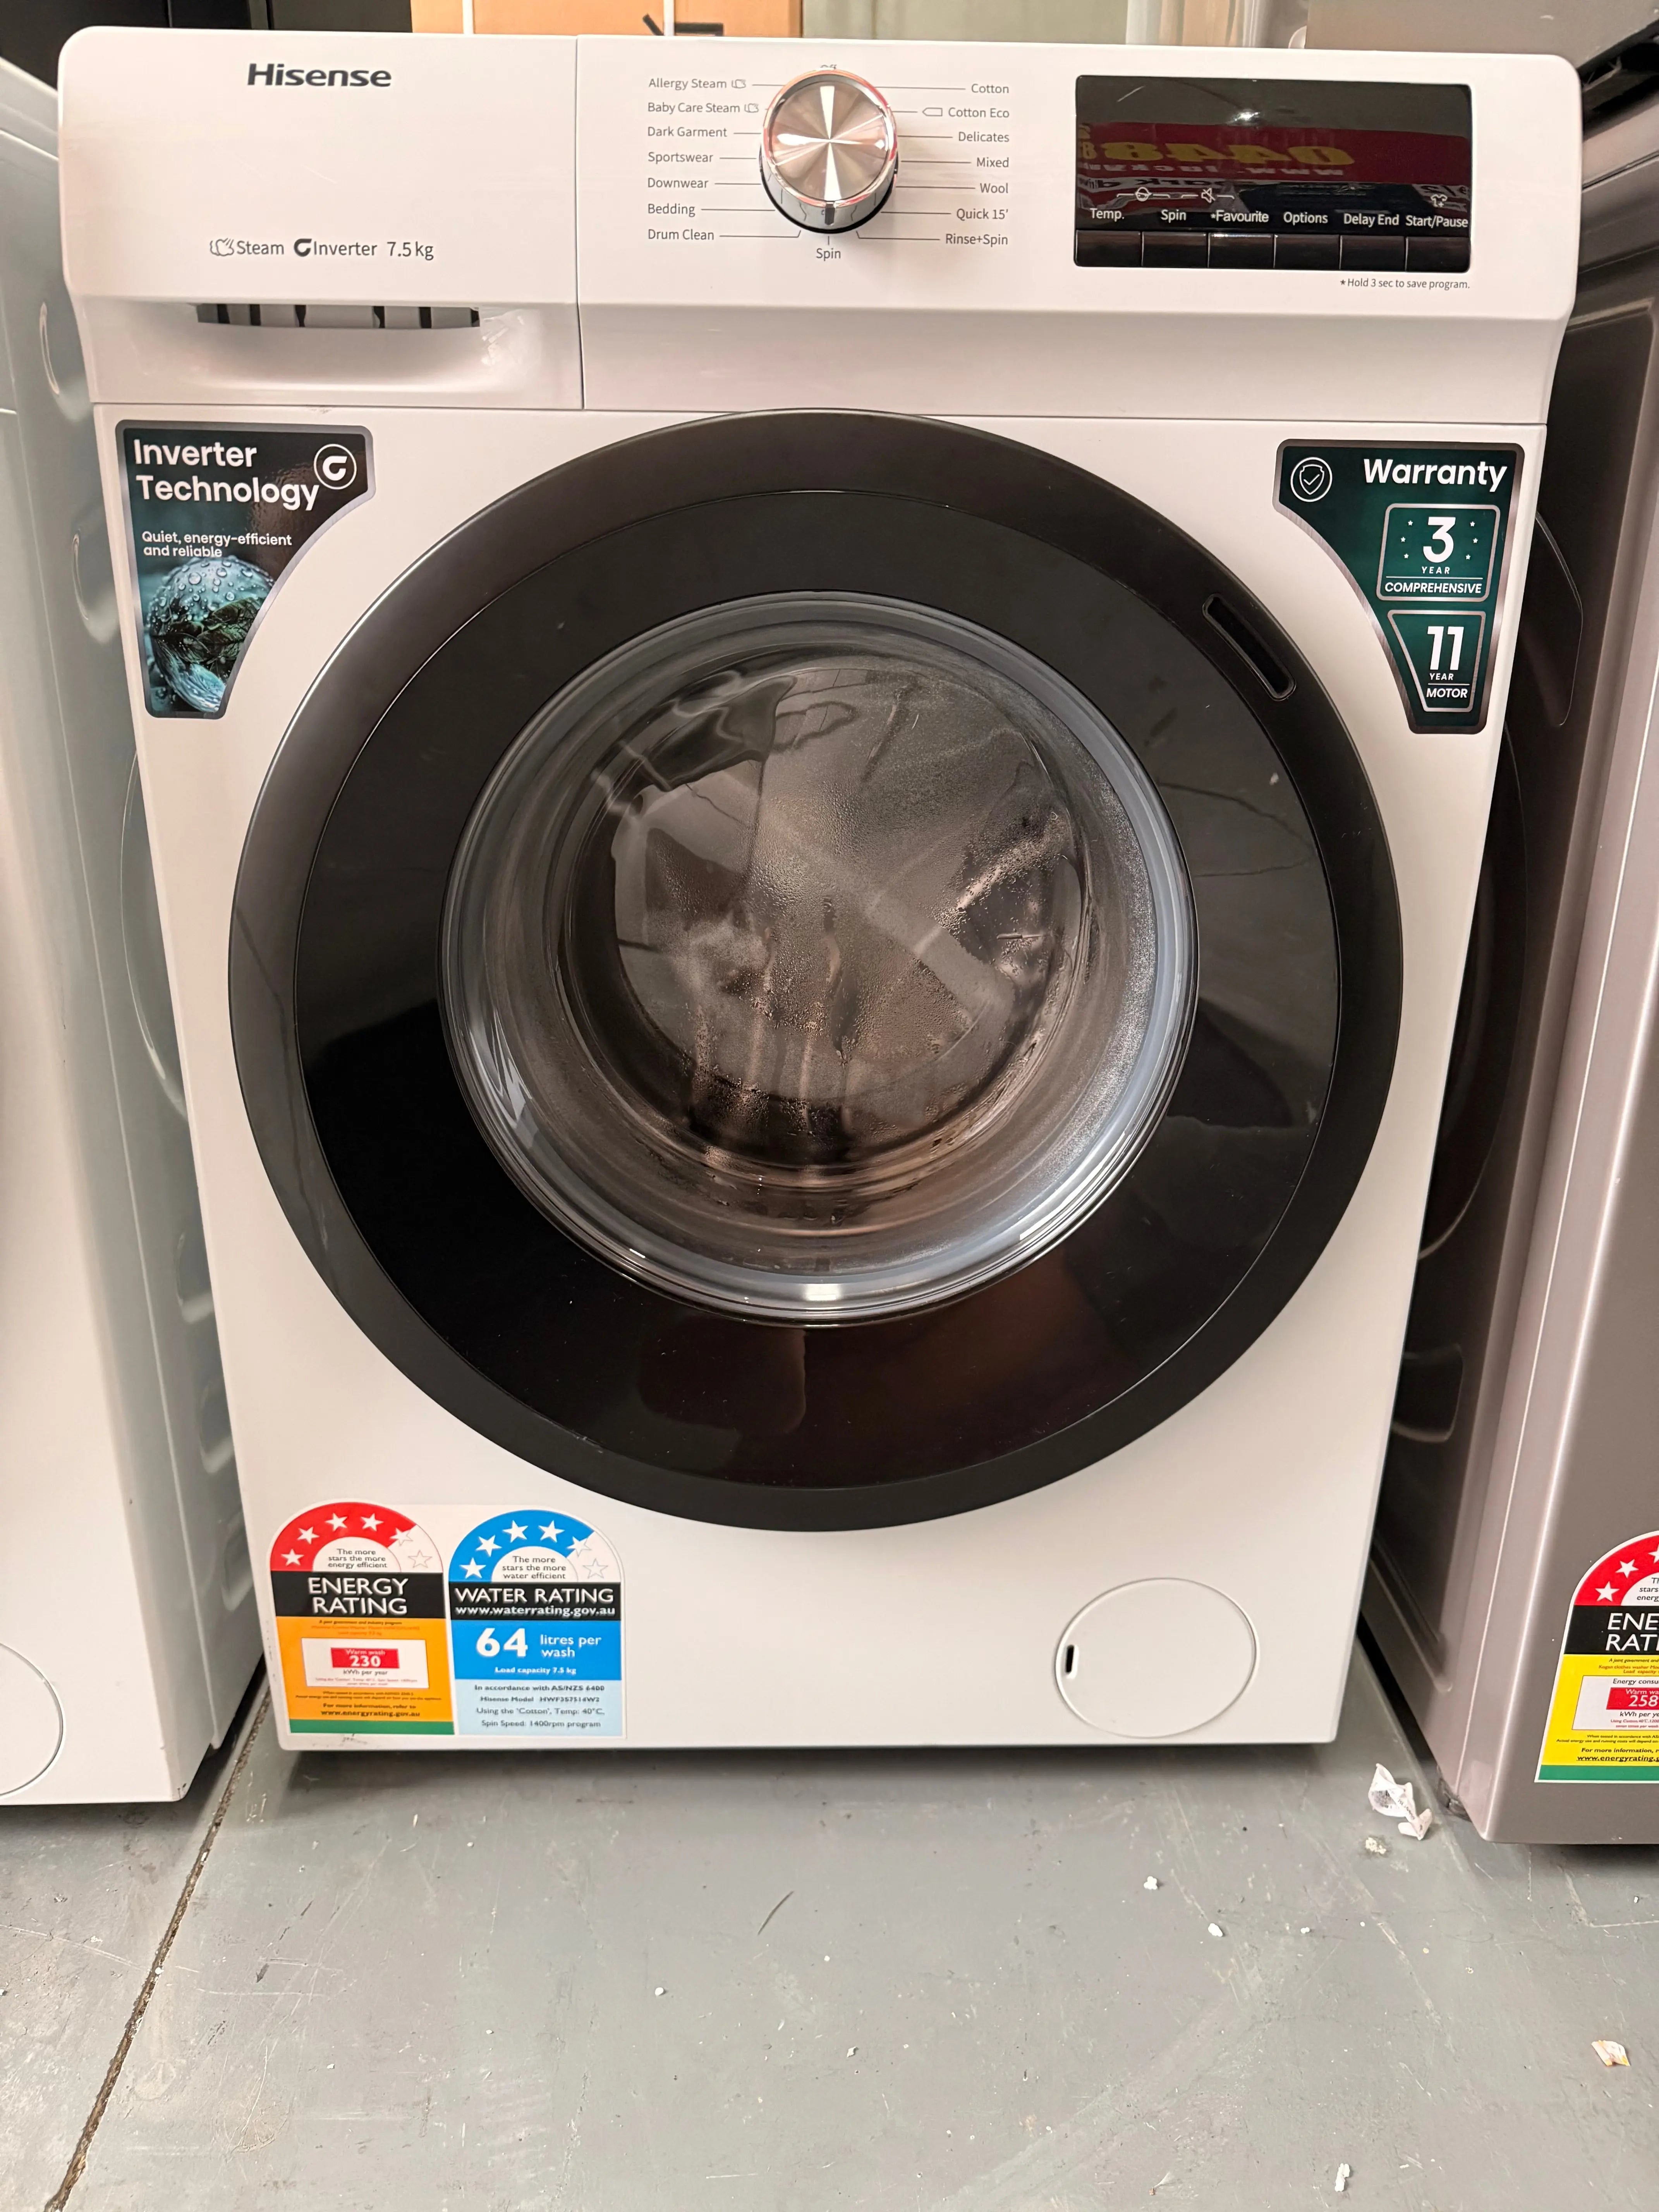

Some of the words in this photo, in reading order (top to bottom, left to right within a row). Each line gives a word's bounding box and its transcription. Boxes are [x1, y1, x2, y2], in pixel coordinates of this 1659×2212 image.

[247, 63, 392, 87] Hisense
[649, 79, 688, 90] Allergy
[692, 79, 727, 89] Steam
[971, 84, 1009, 94] Cotton
[648, 102, 675, 115] Baby
[678, 103, 703, 112] Care
[706, 103, 740, 113] Steam
[948, 107, 986, 118] Cotton
[990, 108, 1010, 118] Eco
[647, 127, 674, 137] Dark
[677, 127, 728, 137] Garment
[958, 132, 1010, 143] Delicates
[648, 152, 713, 164] Sportswear
[976, 157, 1009, 168] Mixed
[647, 177, 709, 188] Downwear
[980, 183, 1009, 194] Wool
[648, 203, 696, 217] Bedding
[957, 209, 989, 221] Quick
[992, 209, 1009, 220] 15'
[1090, 208, 1125, 222] Temp.
[1161, 210, 1187, 223] Spin
[1283, 211, 1328, 225] Options
[1344, 213, 1375, 228] Delay
[1378, 214, 1400, 225] End
[1405, 215, 1468, 228] Start/Pause
[648, 229, 679, 240] Drum
[682, 229, 714, 240] Clean
[945, 234, 1008, 247] Rinse+Spin
[237, 240, 284, 256] Steam
[314, 243, 377, 257] Inverter
[387, 242, 411, 257] 7.5
[415, 242, 433, 261] kg
[816, 248, 841, 261] Spin
[1429, 281, 1470, 291] program.
[134, 439, 257, 467] Inverter
[1364, 459, 1508, 493] Warranty
[136, 475, 319, 511] Technology
[142, 531, 181, 544] Quiet,
[184, 532, 292, 547] energy-efficient
[1423, 517, 1456, 563] 3
[143, 545, 170, 556] and
[172, 545, 223, 558] reliable
[1421, 566, 1451, 575] YEAR
[1384, 582, 1482, 594] COMPREHENSIVE
[1427, 626, 1465, 671] 11
[1429, 673, 1454, 681] YEAR
[1426, 688, 1468, 699] MOTOR
[308, 1577, 409, 1596] ENERGY
[455, 1588, 527, 1603] WATER
[535, 1588, 614, 1604] RATING
[312, 1597, 407, 1616] RATING
[455, 1606, 615, 1618] www.waterrating.gov.au
[1607, 1613, 1659, 1630] ENE
[476, 1628, 528, 1657] 64
[540, 1635, 574, 1646] litres
[579, 1637, 602, 1648] per
[1606, 1634, 1659, 1651] RATI
[541, 1647, 575, 1657] wash
[349, 1655, 381, 1667] 230
[517, 1667, 550, 1675] capacity
[1628, 1695, 1659, 1707] 258
